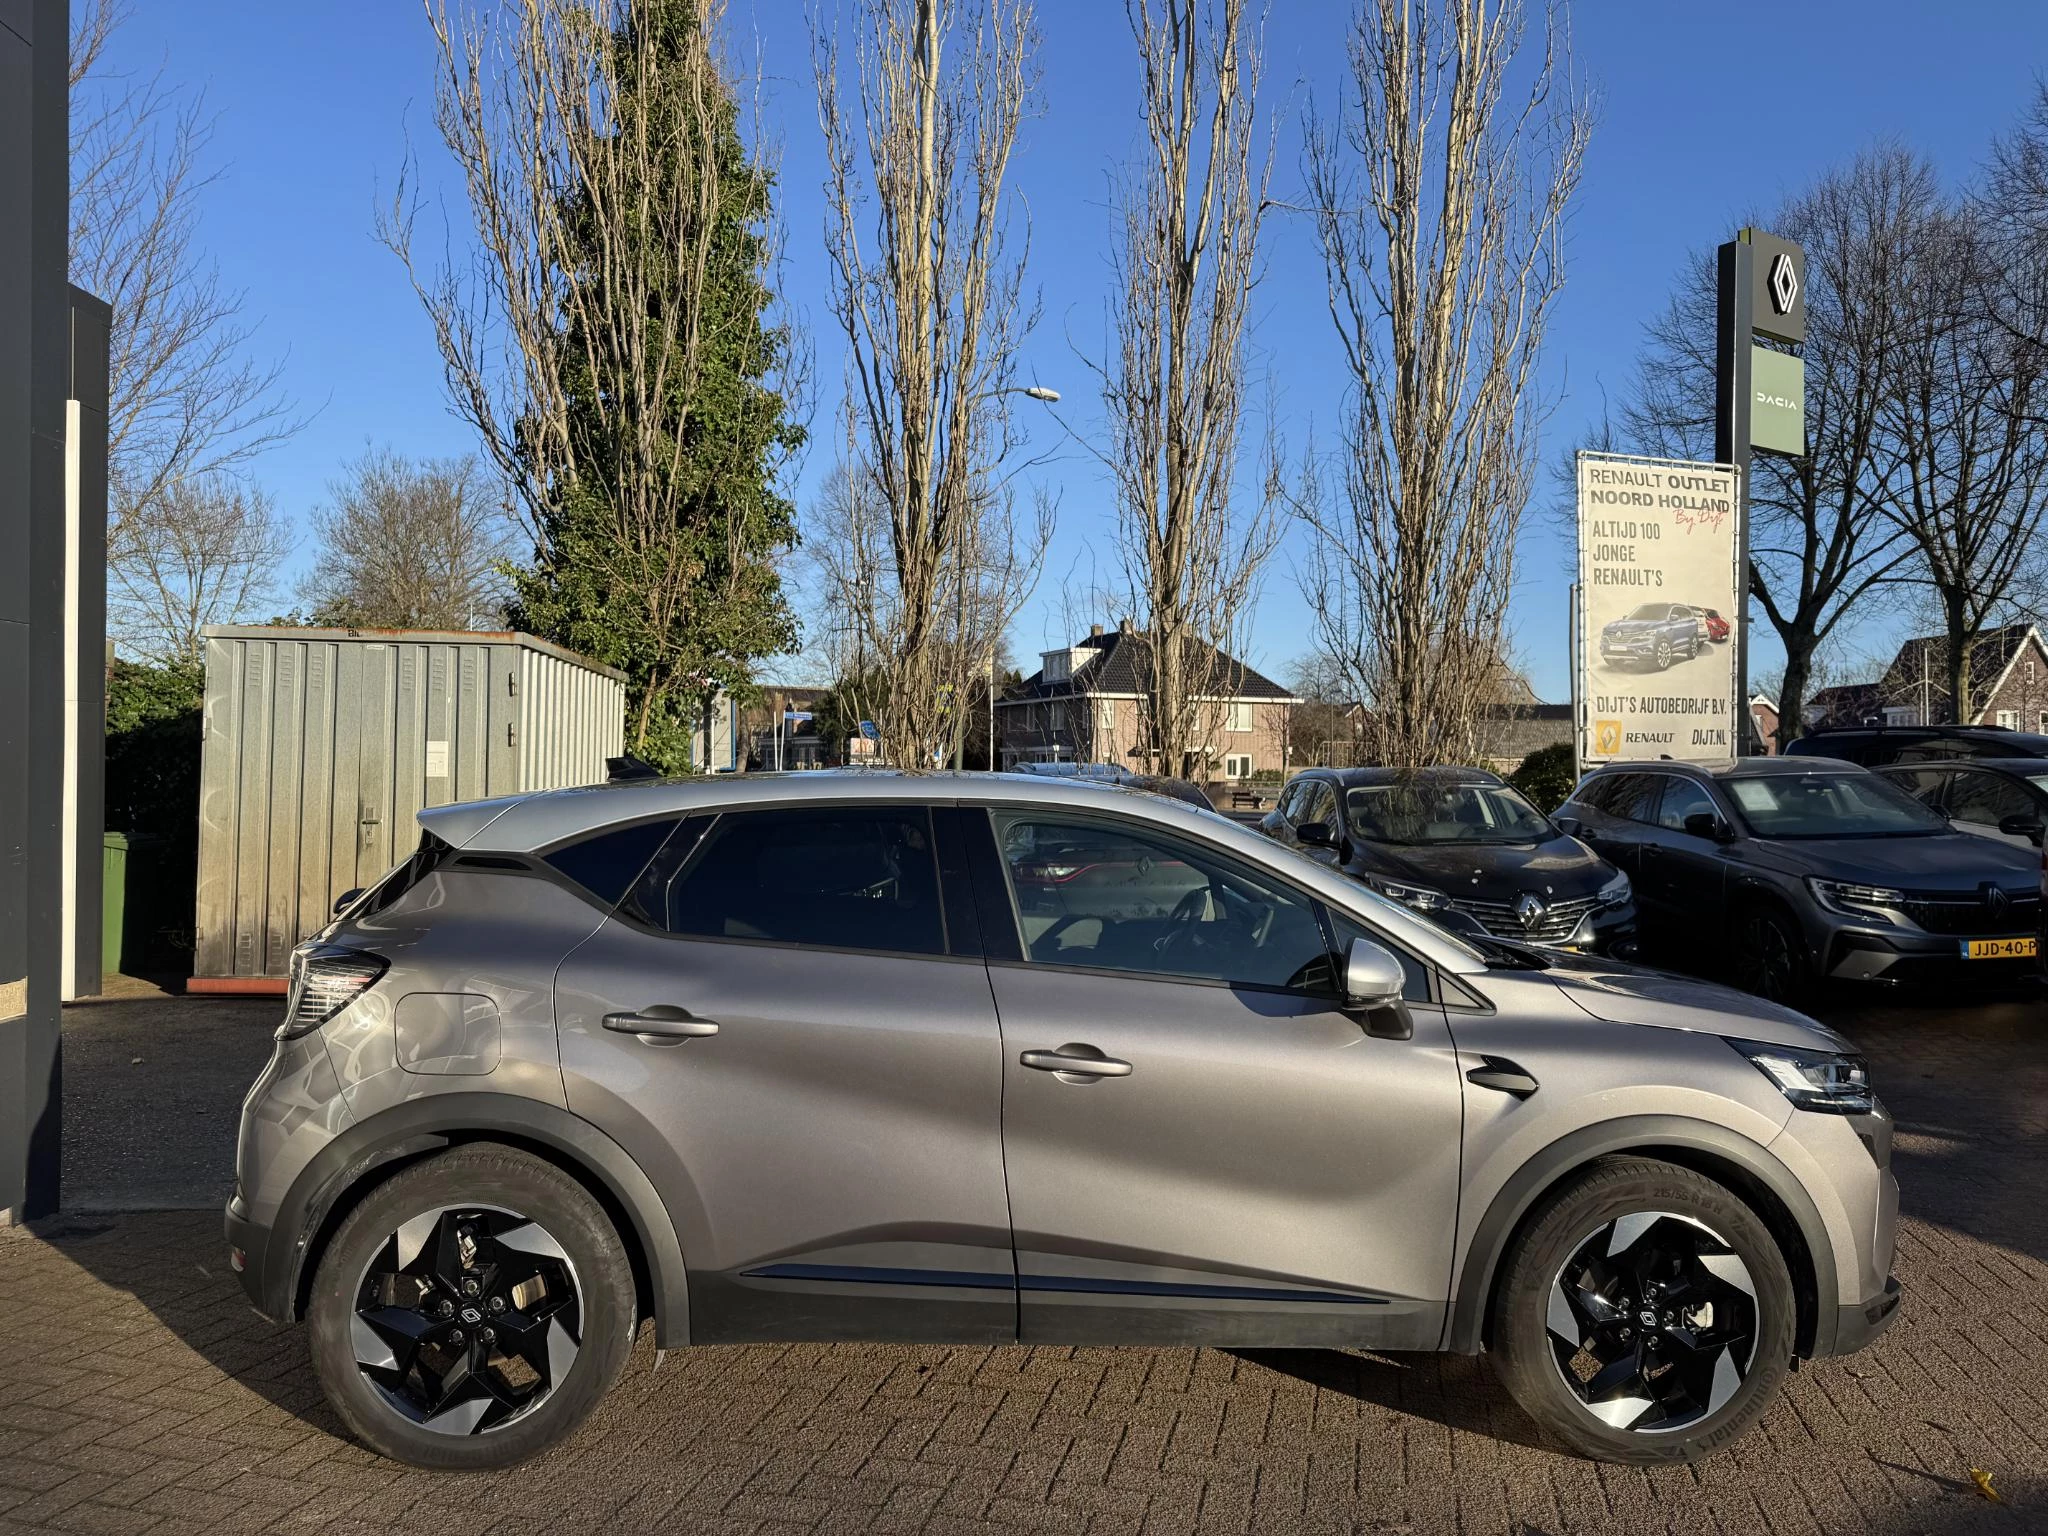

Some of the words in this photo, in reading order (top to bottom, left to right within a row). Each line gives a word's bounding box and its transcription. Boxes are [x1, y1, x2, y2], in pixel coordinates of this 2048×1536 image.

[1756, 392, 1797, 410] DACIA
[1590, 469, 1662, 488] RENAULT
[1667, 475, 1730, 493] OUTLET
[1591, 490, 1654, 506] NOORD
[1658, 494, 1730, 513] HOLLAND
[1592, 521, 1637, 539] ALTIJD
[1640, 523, 1660, 540] 100
[1673, 509, 1696, 535] By
[1593, 544, 1636, 562] JONGE
[1593, 568, 1663, 587] RENAULT'S
[1596, 696, 1637, 713] DIJT'S
[1639, 698, 1709, 715] AUTOBEDRIJF
[1712, 698, 1727, 715] B.V.
[1625, 732, 1676, 743] RENAULT
[1692, 729, 1727, 745] DIJT.NL
[1974, 941, 2037, 957] JJD-40-P
[1707, 1366, 1778, 1447] Continental
